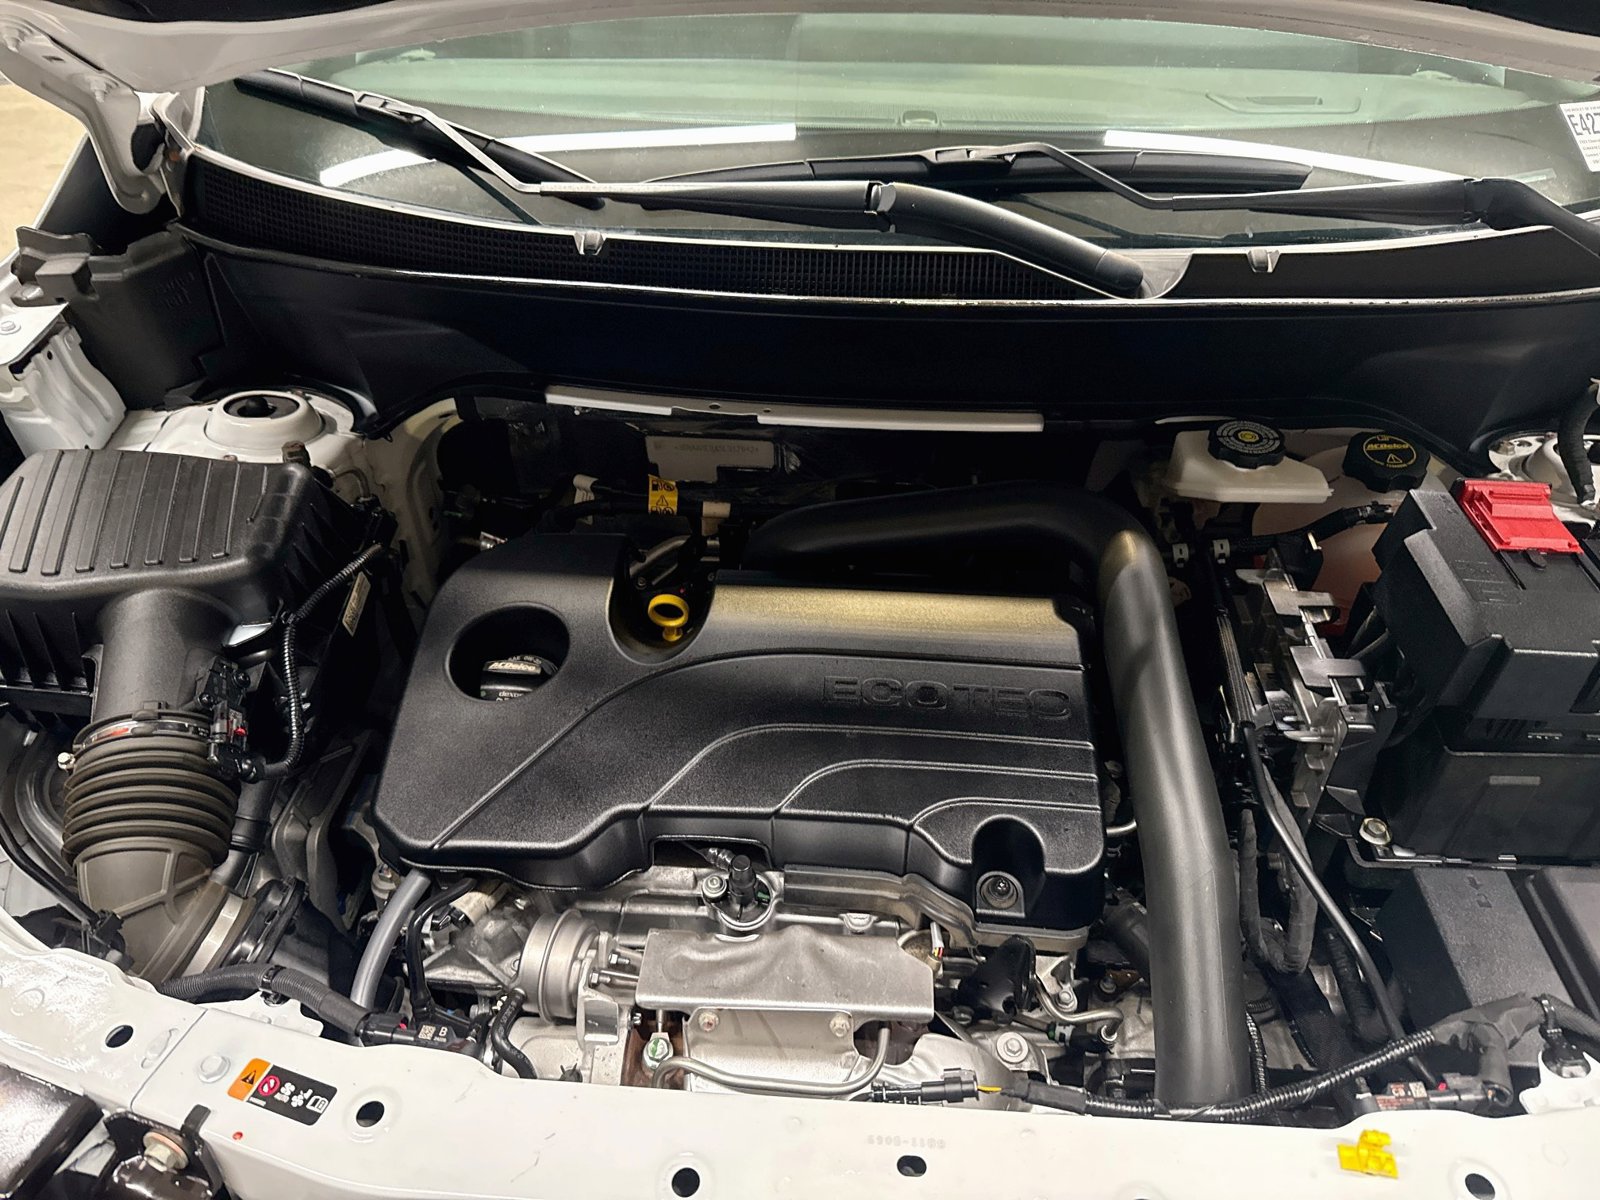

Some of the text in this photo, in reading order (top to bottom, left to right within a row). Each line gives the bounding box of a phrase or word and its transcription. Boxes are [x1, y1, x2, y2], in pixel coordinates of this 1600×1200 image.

[488, 662, 536, 671] ACDelco
[823, 676, 1072, 721] ECOTEC
[438, 1026, 448, 1037] B
